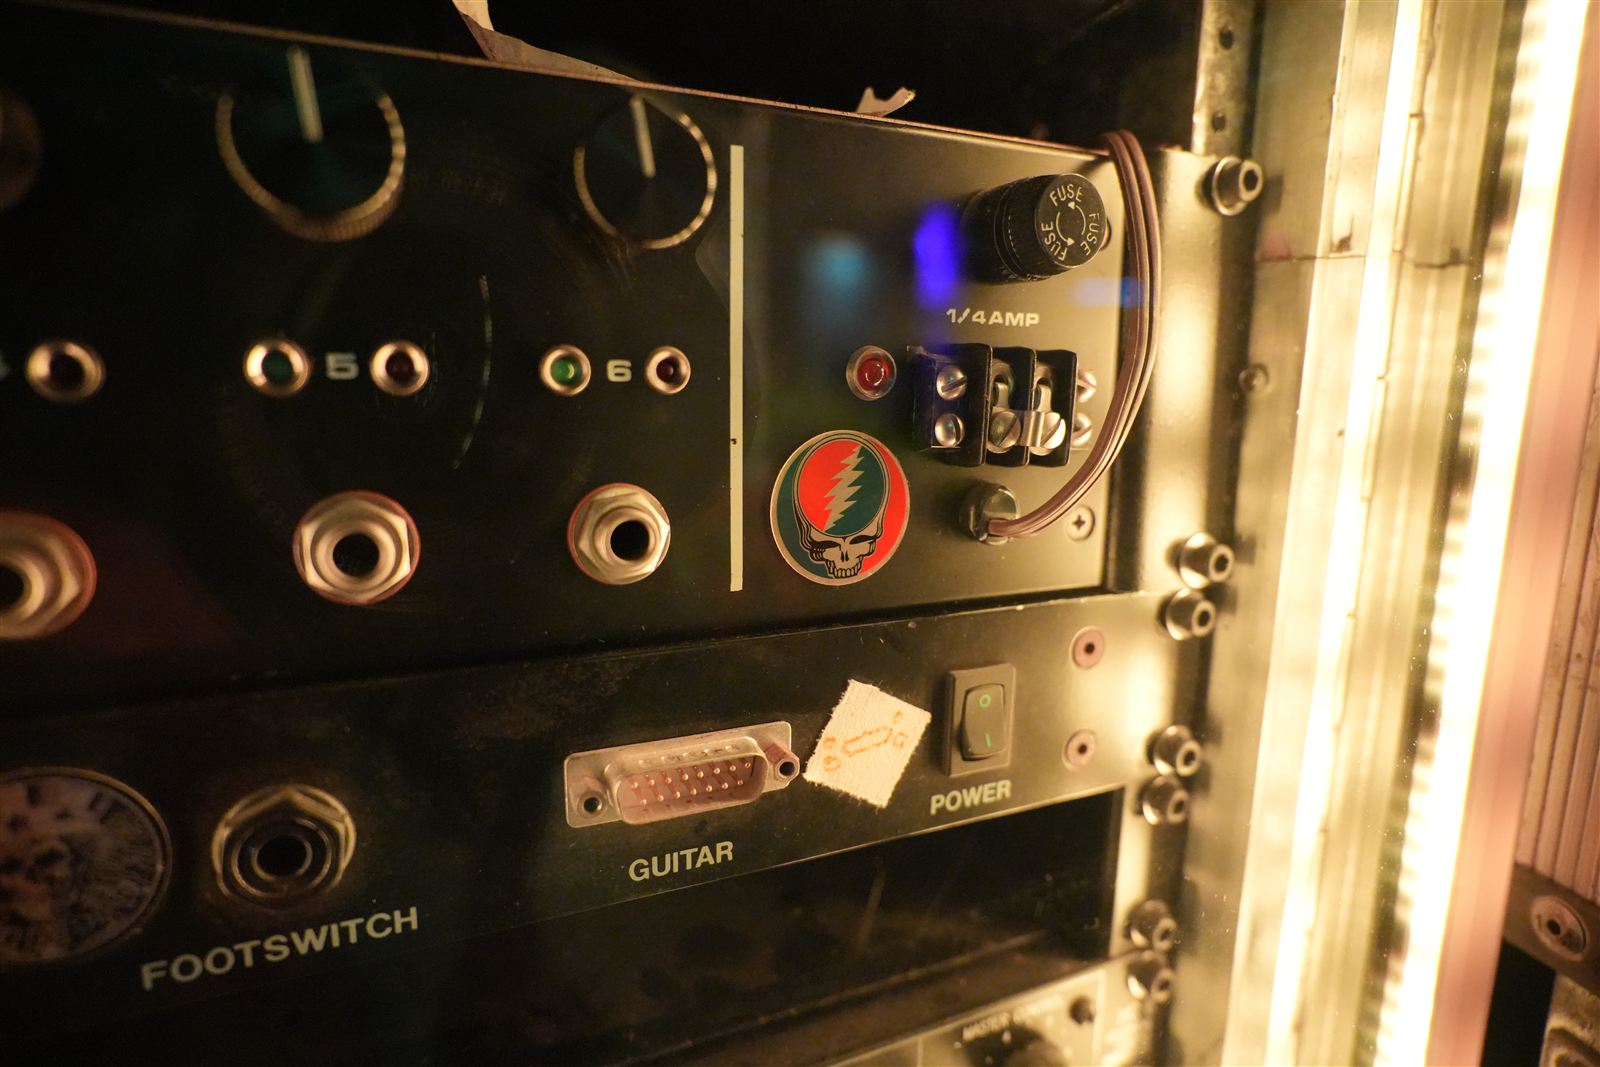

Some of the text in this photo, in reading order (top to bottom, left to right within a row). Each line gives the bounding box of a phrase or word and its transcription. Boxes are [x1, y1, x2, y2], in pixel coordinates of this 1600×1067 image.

[1049, 183, 1084, 207] FUSE
[1041, 220, 1068, 262] FUSE
[1080, 212, 1100, 256] FUSE
[324, 352, 358, 381] 5
[606, 359, 632, 383] 6
[929, 779, 1012, 816] POWER
[628, 840, 734, 883] GUITAR
[140, 905, 419, 992] FOOTSWITCH
